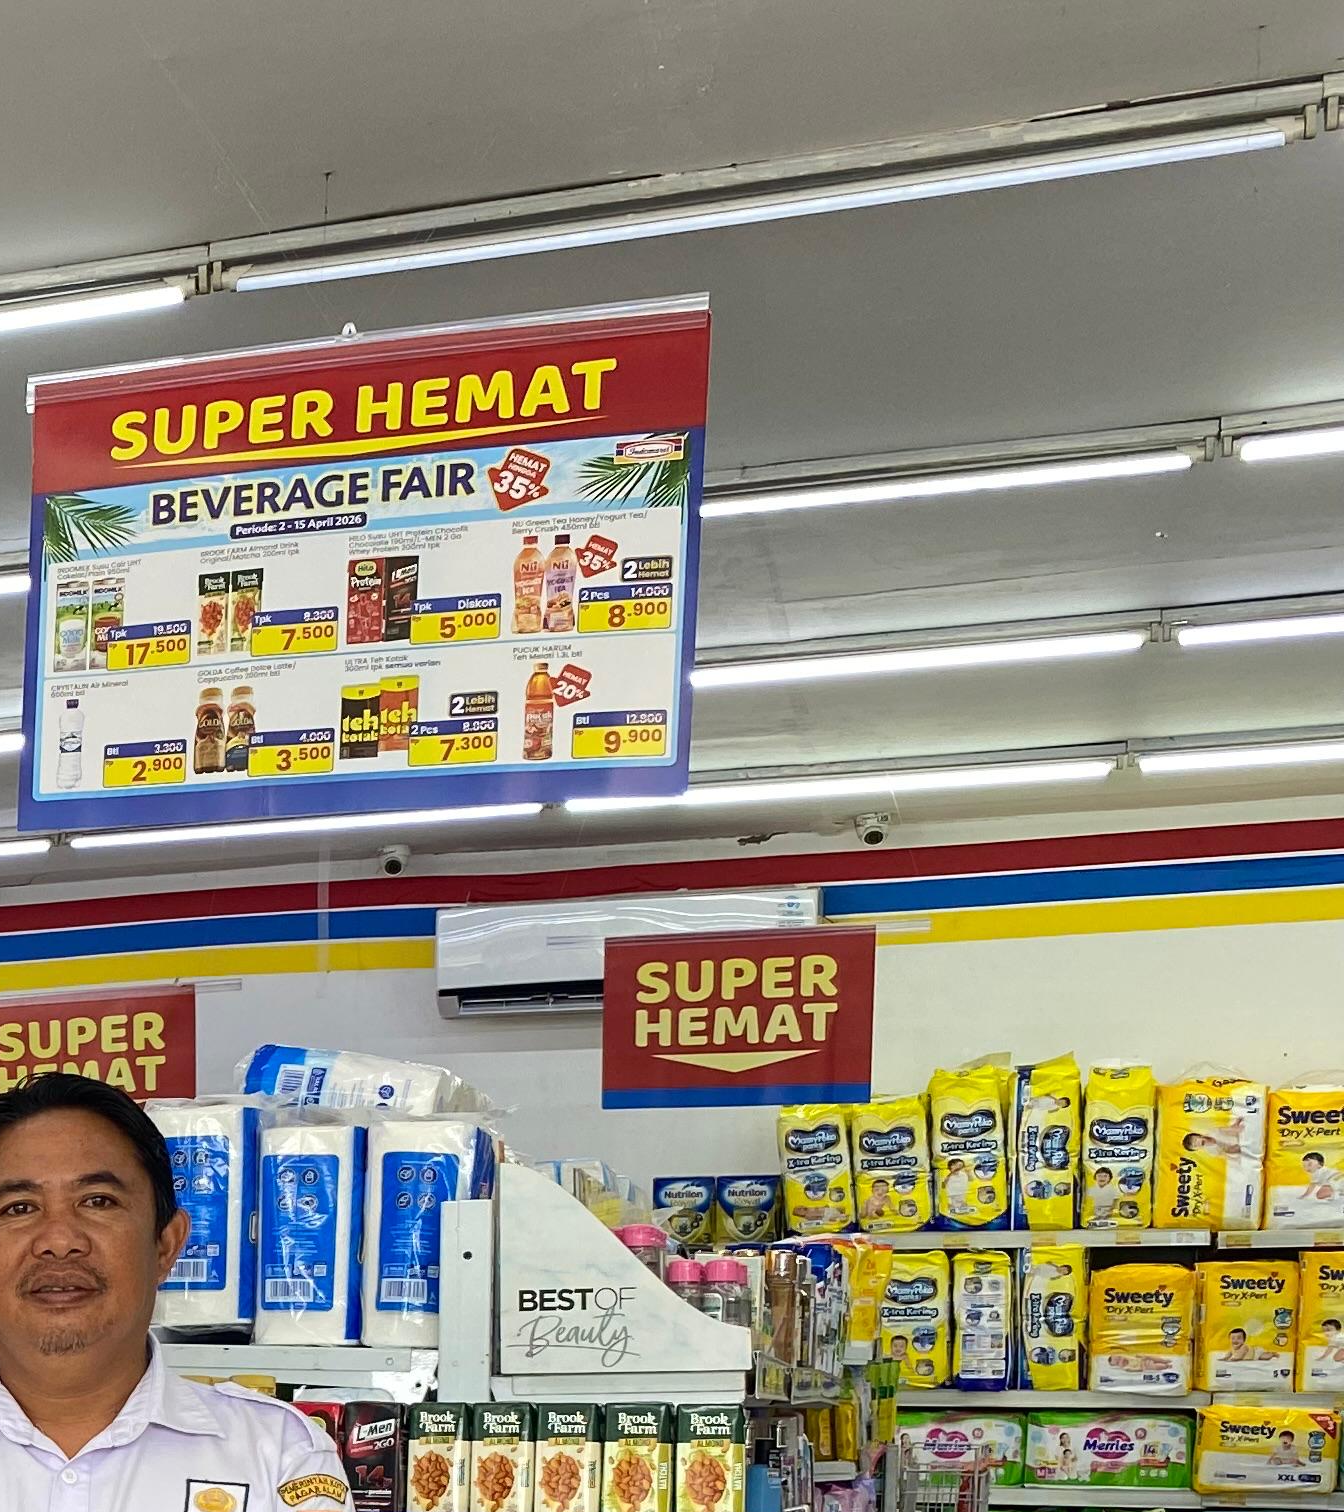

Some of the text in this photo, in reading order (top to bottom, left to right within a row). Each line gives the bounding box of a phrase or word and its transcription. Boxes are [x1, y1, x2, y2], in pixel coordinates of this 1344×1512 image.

[110, 358, 618, 461] SUPER HEMAT
[152, 463, 475, 526] BEVERAGE FAIR
[493, 471, 540, 501] 35%
[235, 521, 276, 536] Periode:
[278, 520, 285, 531] 2
[294, 518, 306, 530] 15
[307, 516, 334, 529] April
[335, 514, 363, 526] 2026
[414, 597, 497, 613] Tpk Diskon
[581, 590, 610, 600] 2 Pcs
[439, 612, 496, 640] 5.000
[607, 602, 668, 628] 8.900
[281, 626, 334, 651] 7.500
[126, 639, 187, 667] 17.500
[440, 736, 494, 761] 7.300
[604, 729, 662, 753] 9.900
[132, 758, 184, 782] 2.900
[276, 747, 331, 772] 3.500
[635, 955, 838, 1004] SUPER
[634, 1002, 838, 1047] HEMAT
[728, 1189, 767, 1197] Nutrilon
[1104, 1285, 1174, 1307] Sweety
[506, 1310, 640, 1367] Beauty
[419, 1410, 458, 1426] Brook
[425, 1422, 457, 1436] Farm
[547, 1412, 585, 1426] Brook
[548, 1423, 585, 1436] Farm
[691, 1413, 729, 1426] Brook
[356, 1420, 394, 1443] L-Men
[691, 1424, 730, 1437] Farm
[1082, 1438, 1135, 1453] Merries
